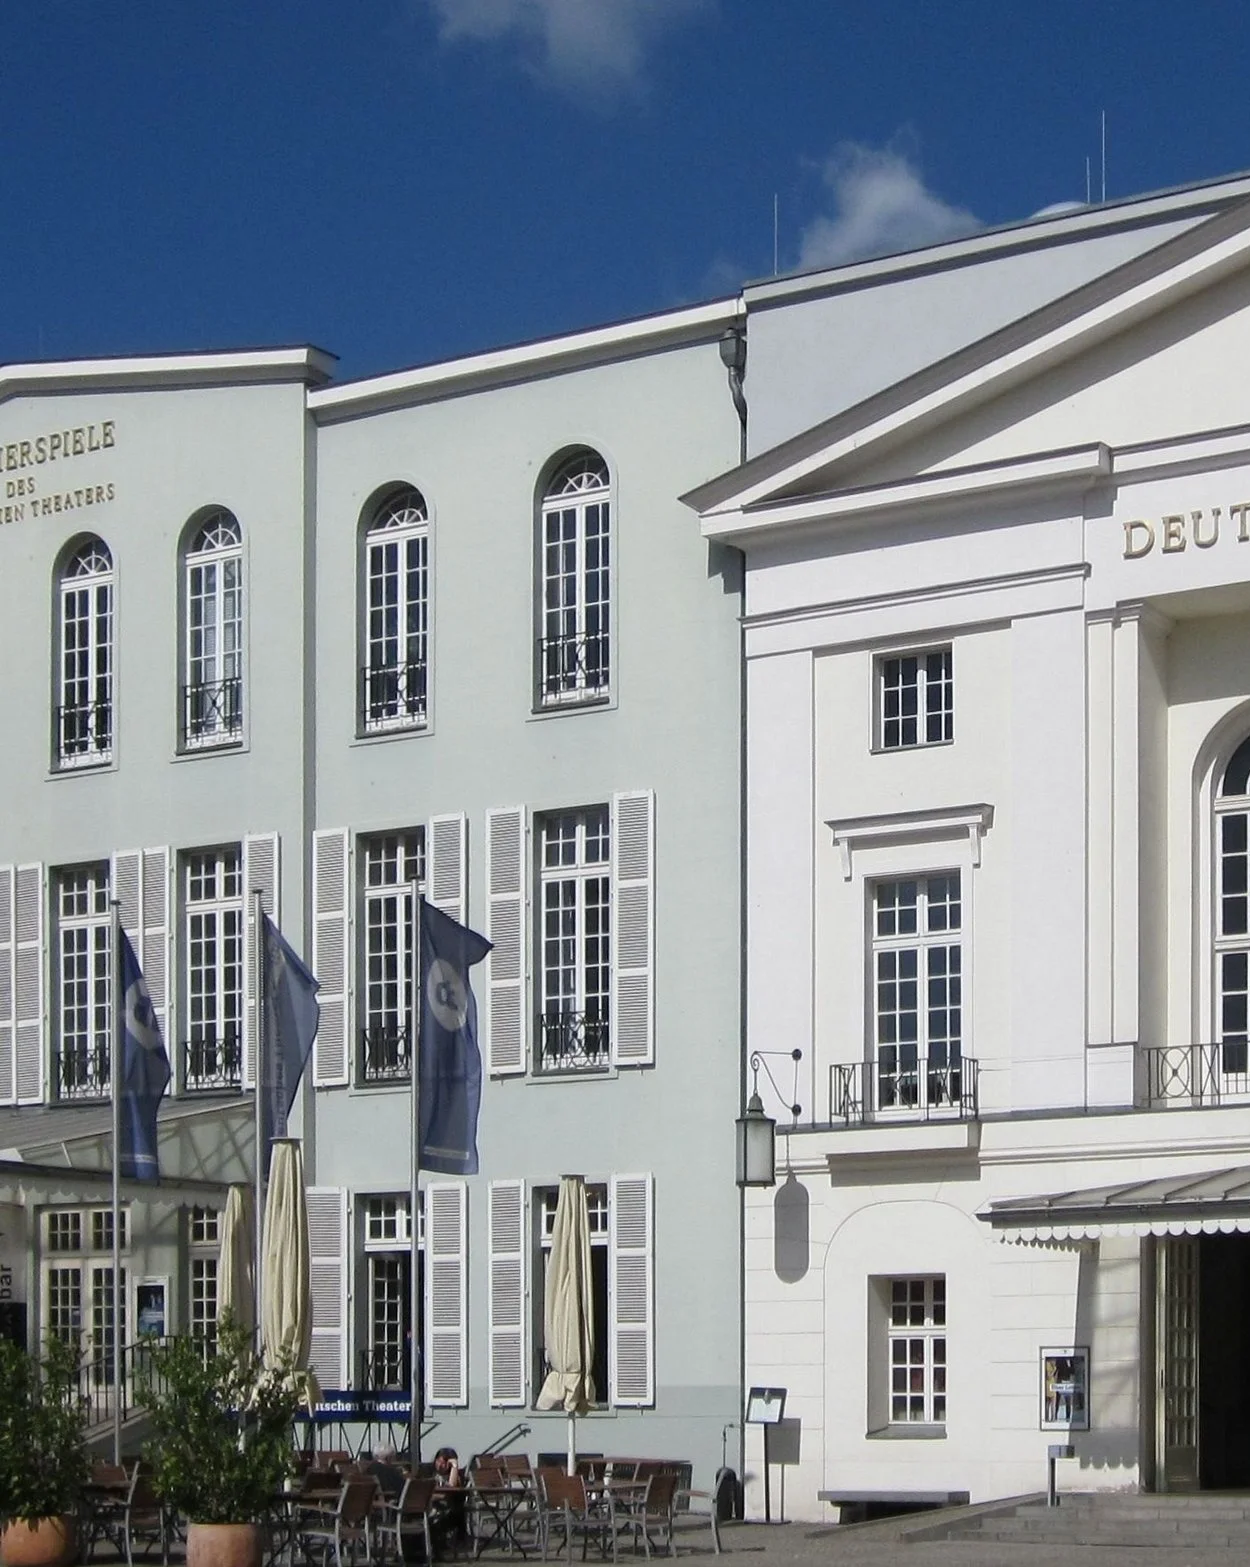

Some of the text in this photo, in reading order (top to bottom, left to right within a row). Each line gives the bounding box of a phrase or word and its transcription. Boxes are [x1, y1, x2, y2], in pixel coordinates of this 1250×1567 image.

[0, 421, 115, 473] ERSPIELE
[7, 477, 35, 498] DES
[0, 483, 114, 524] EN THEATERS
[363, 1400, 412, 1412] Theater
